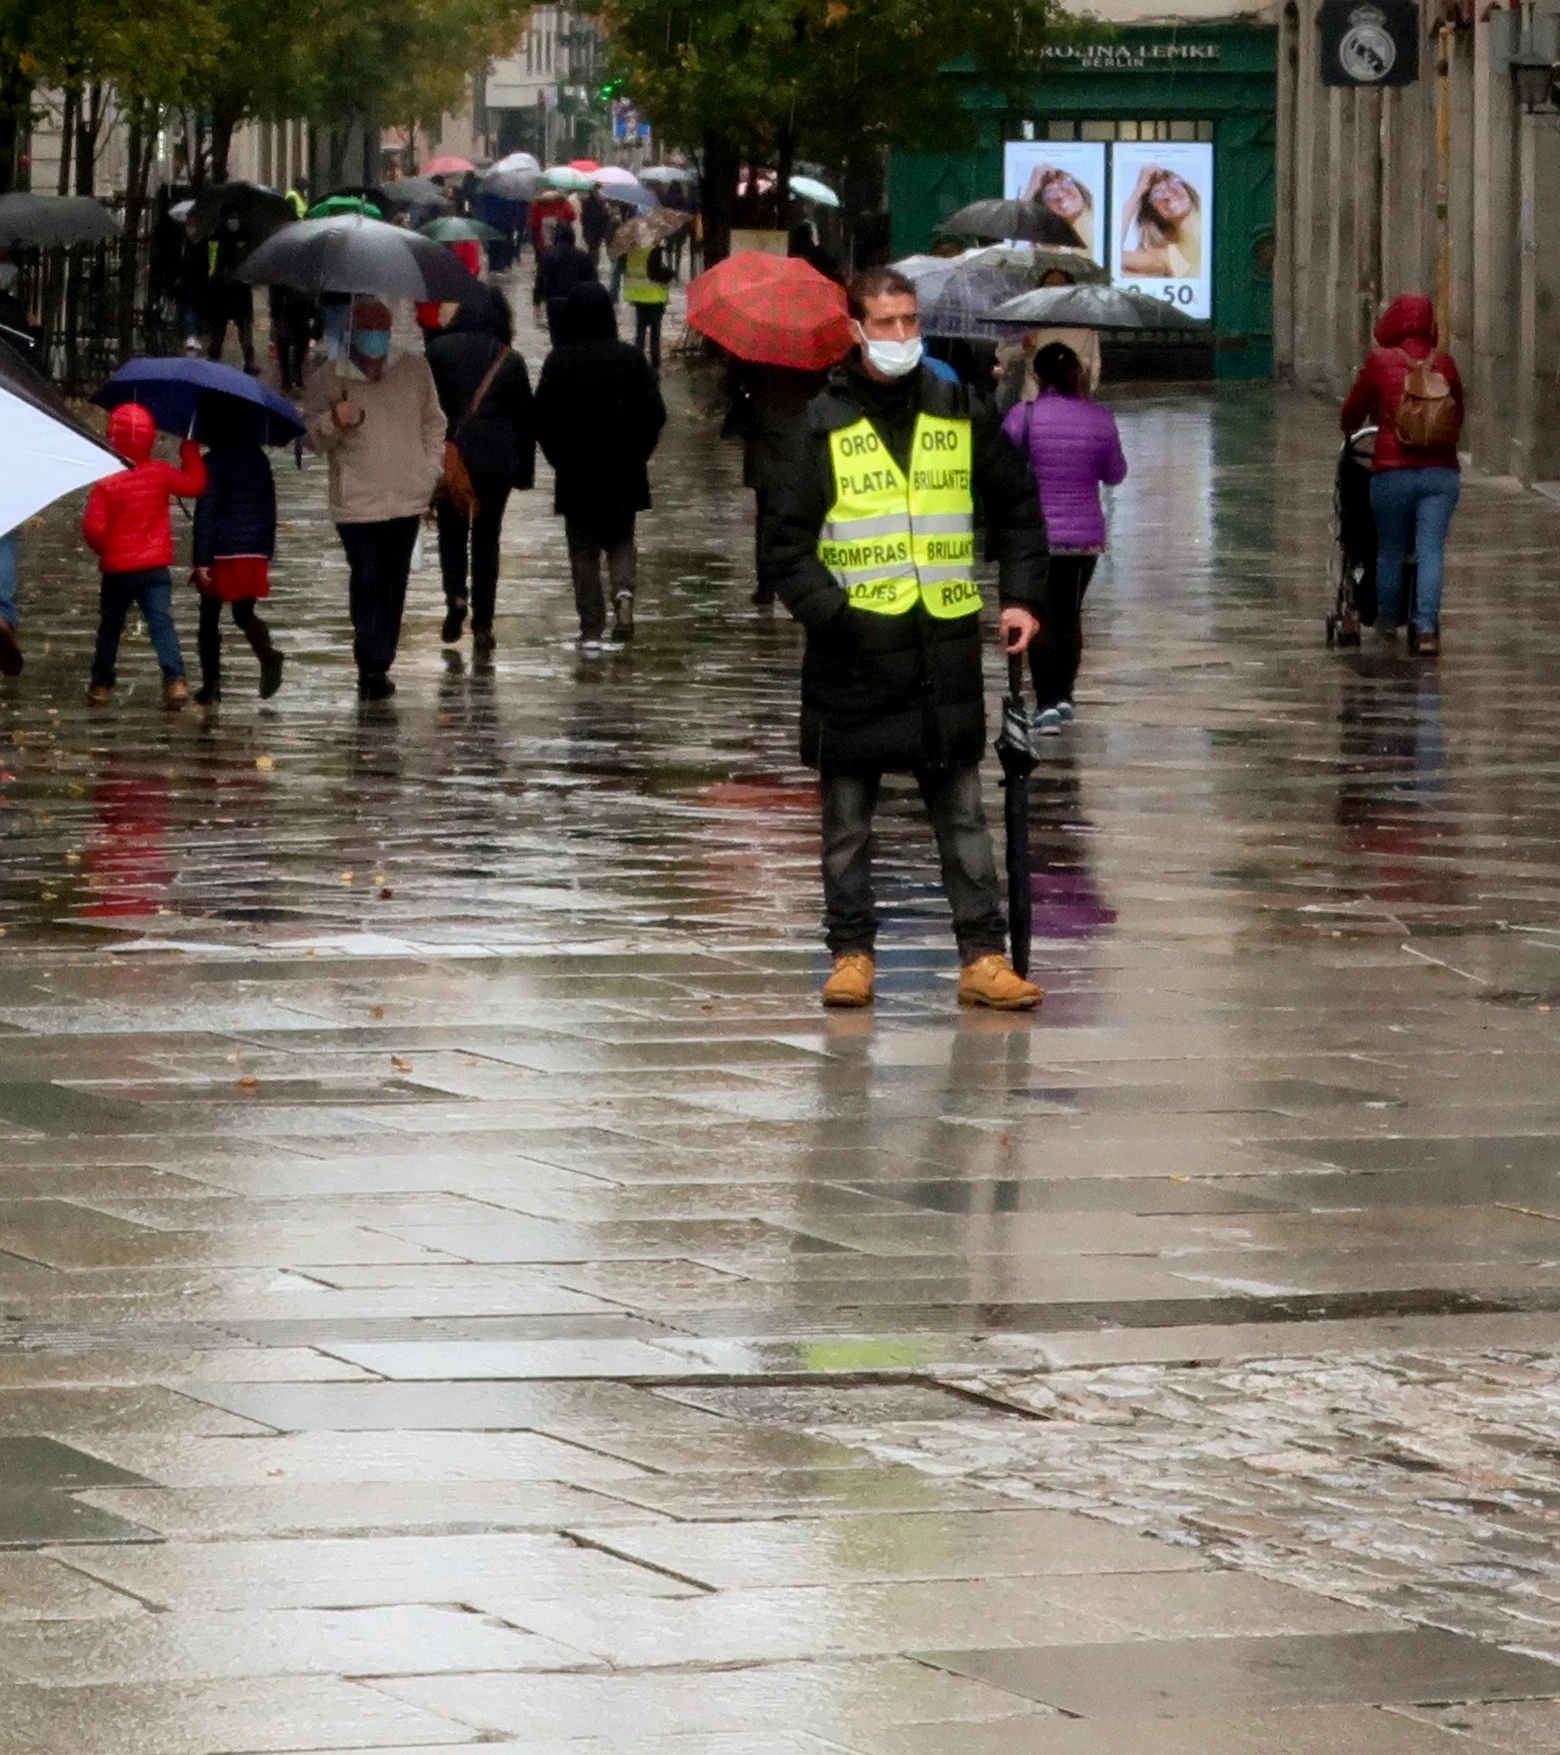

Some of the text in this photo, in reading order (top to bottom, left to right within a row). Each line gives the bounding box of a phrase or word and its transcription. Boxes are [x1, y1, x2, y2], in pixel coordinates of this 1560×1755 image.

[1141, 44, 1221, 58] LEMKE
[1082, 57, 1144, 67] BERLIN
[840, 433, 879, 457] ORO
[921, 430, 958, 451] ORO
[840, 469, 897, 495] PLATA
